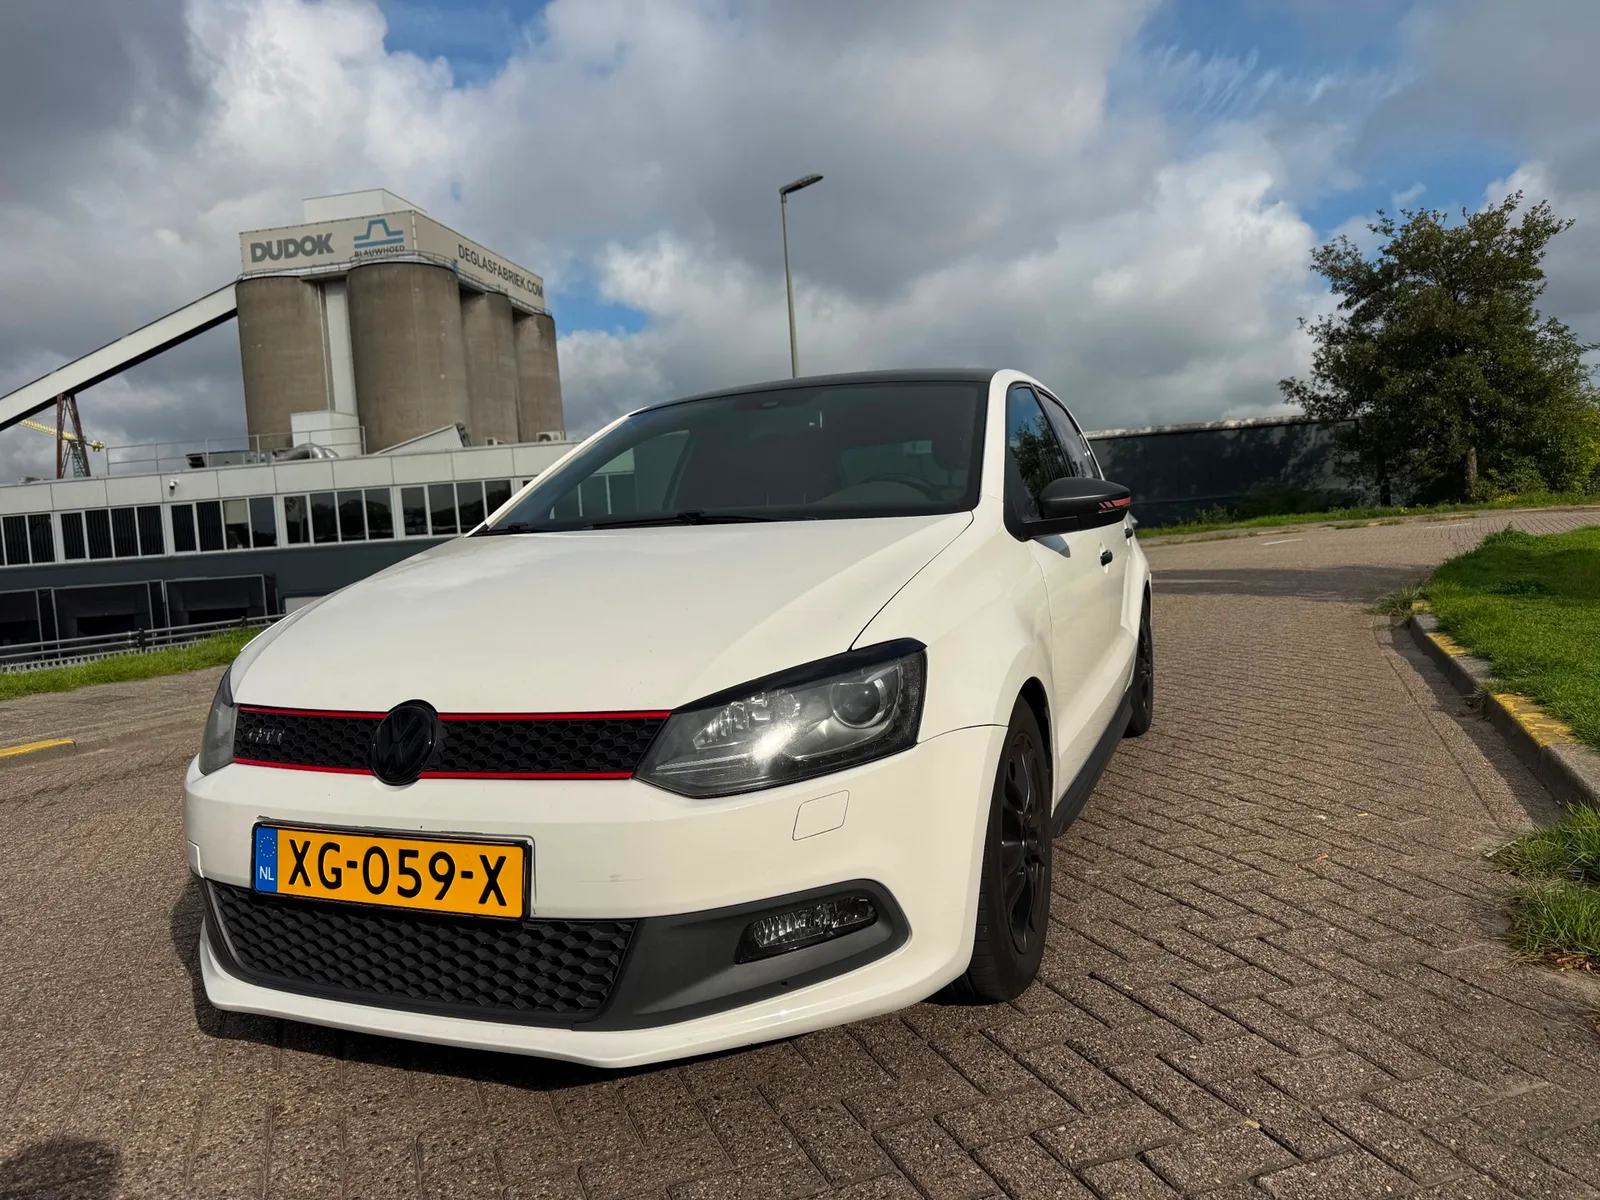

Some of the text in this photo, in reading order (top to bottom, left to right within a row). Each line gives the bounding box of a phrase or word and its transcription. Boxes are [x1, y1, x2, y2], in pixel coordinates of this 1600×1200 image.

[250, 233, 334, 263] DUDOK
[354, 245, 405, 257] BLAUWHOED
[458, 244, 544, 298] DEGLASFABRIEK.COM
[259, 866, 275, 882] NL
[288, 839, 508, 907] XG-059-X
